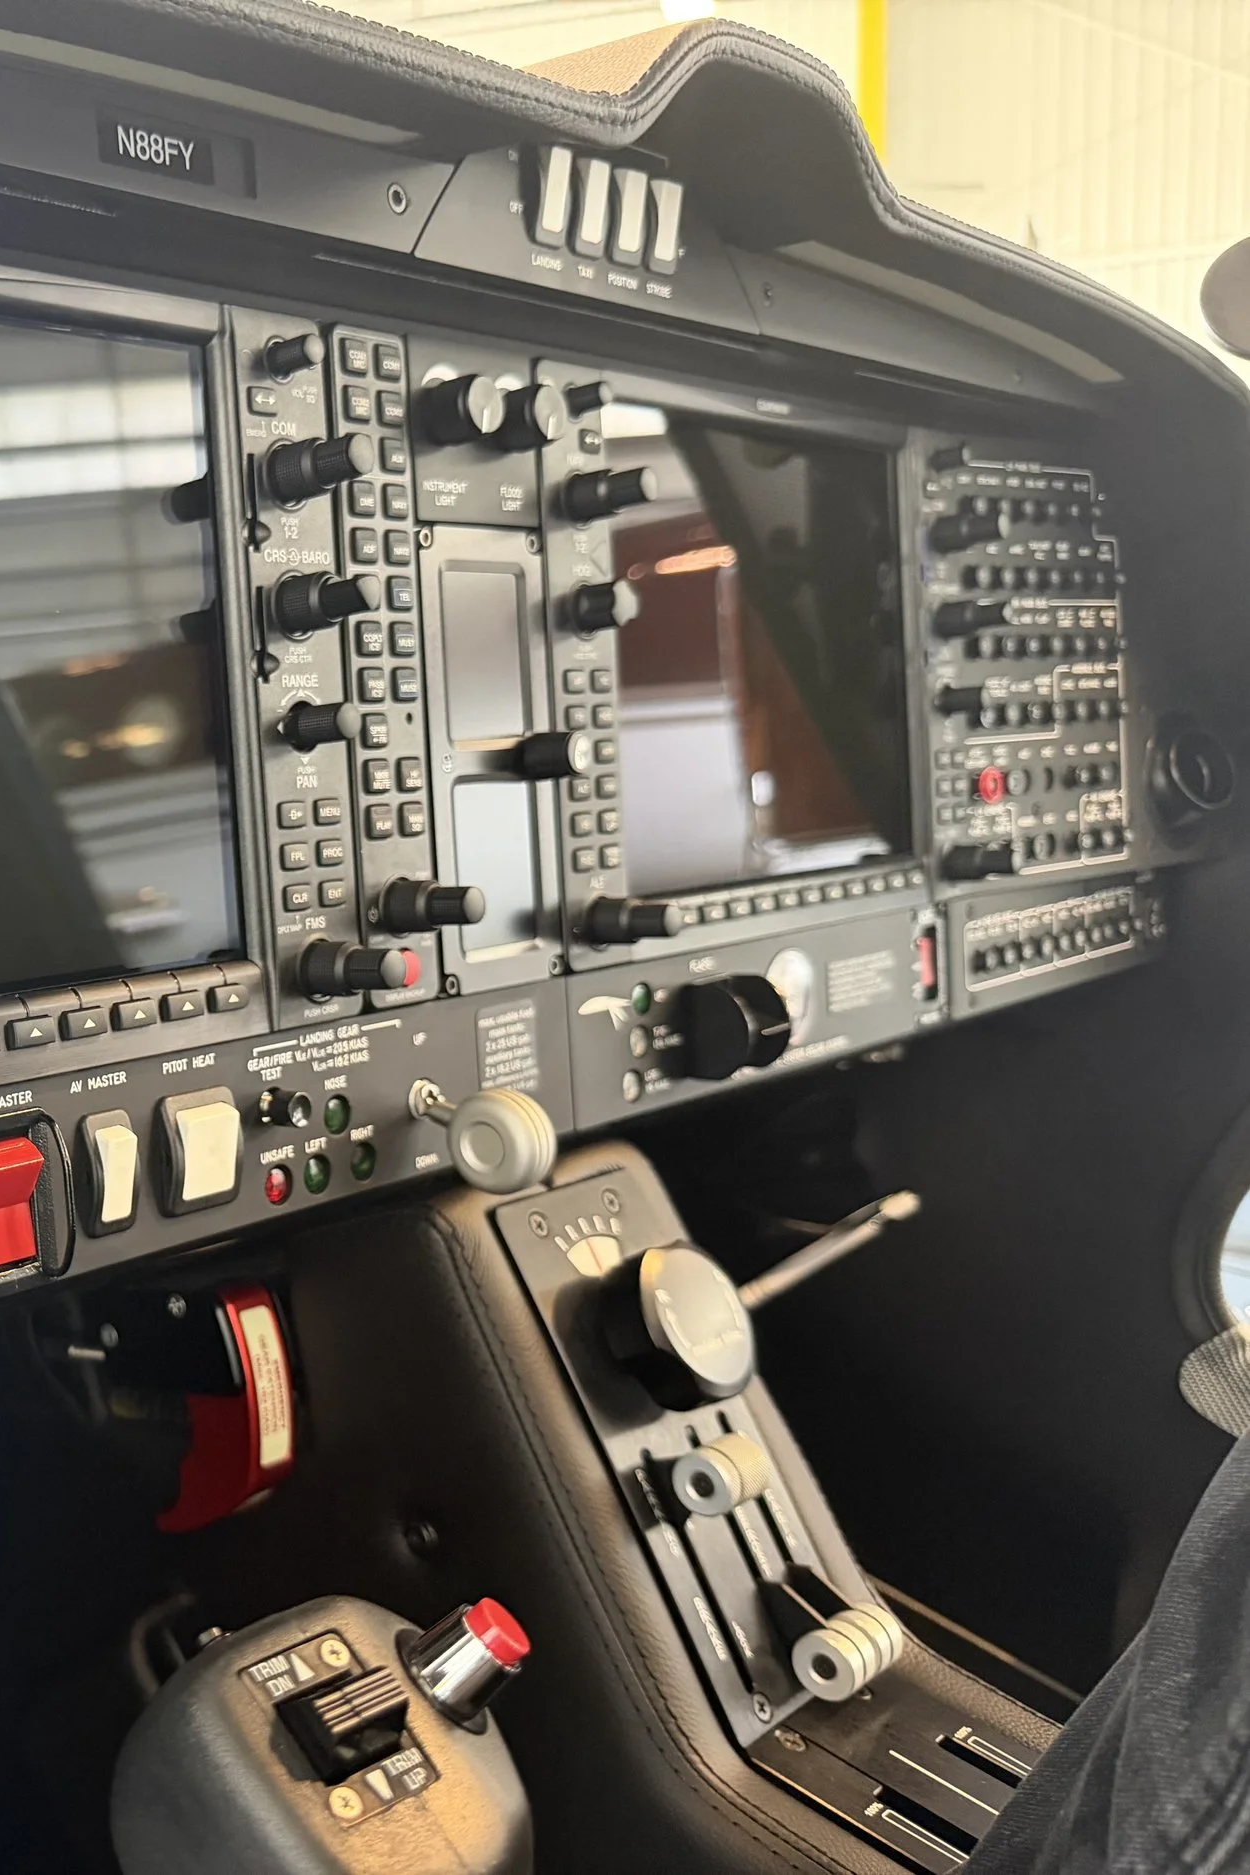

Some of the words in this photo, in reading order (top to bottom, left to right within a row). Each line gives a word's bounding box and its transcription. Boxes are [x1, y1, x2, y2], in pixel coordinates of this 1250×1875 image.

[116, 124, 195, 171] N88FY
[271, 421, 297, 437] COM
[423, 481, 469, 495] INSTRUMENT
[282, 675, 319, 689] RANGE
[296, 775, 318, 790] PAN
[320, 807, 341, 818] MENU
[291, 852, 306, 862] FPL
[323, 847, 343, 859] PROC
[293, 893, 308, 904] CLR
[305, 916, 326, 930] FMS
[299, 1028, 335, 1047] LANDING
[336, 1023, 360, 1039] GEAR
[162, 1058, 188, 1075] PITOT
[192, 1052, 216, 1069] HEAT
[260, 1066, 282, 1082] TEST
[70, 1079, 83, 1094] AV
[87, 1071, 127, 1090] MASTER
[324, 1074, 348, 1091] NOSE
[350, 1125, 376, 1142] RIGHT
[304, 1137, 328, 1153] LEFT
[260, 1144, 295, 1165] UNSAFE
[249, 1656, 290, 1682] TRIM
[267, 1673, 296, 1698] DN
[384, 1747, 425, 1777] TRIM
[403, 1766, 431, 1790] UP
